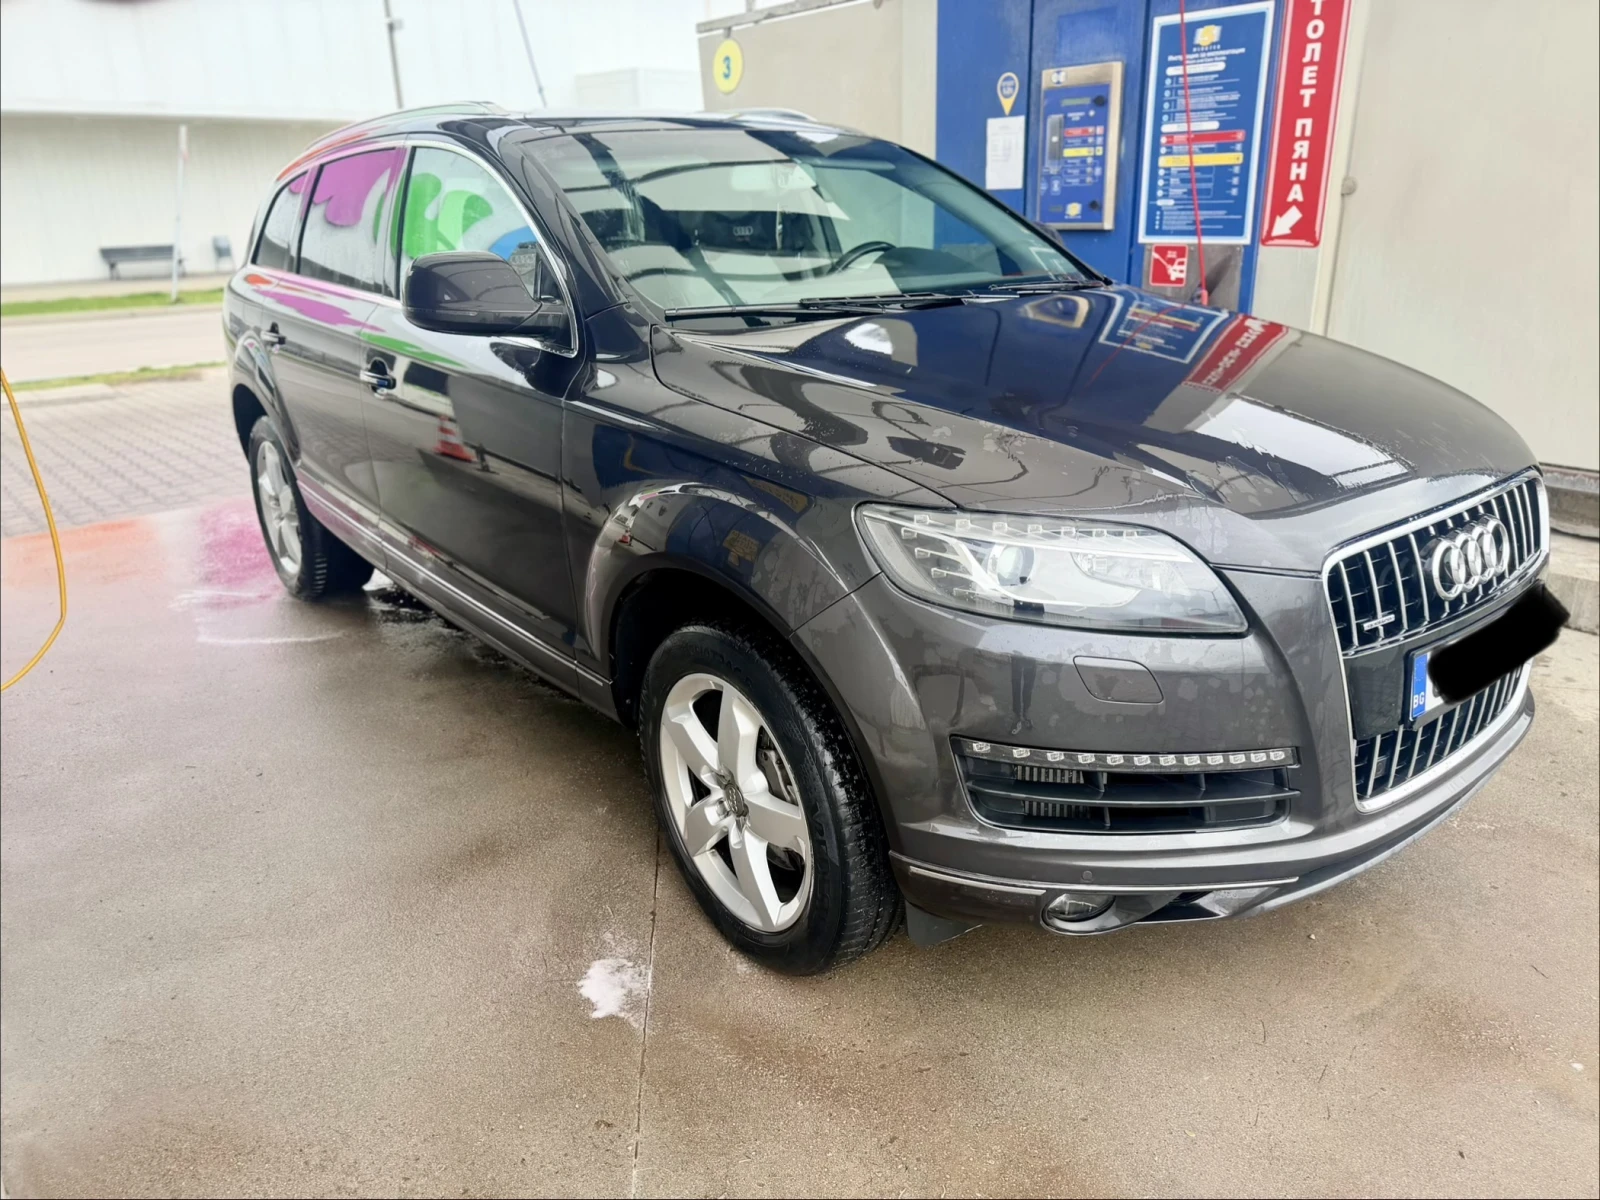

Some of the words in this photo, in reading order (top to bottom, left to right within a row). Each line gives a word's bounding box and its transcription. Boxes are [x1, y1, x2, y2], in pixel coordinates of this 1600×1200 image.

[723, 55, 731, 80] 3
[1300, 0, 1325, 108] ТОЛЕТ
[1286, 118, 1313, 202] ПЯНА
[1413, 691, 1425, 708] BG
